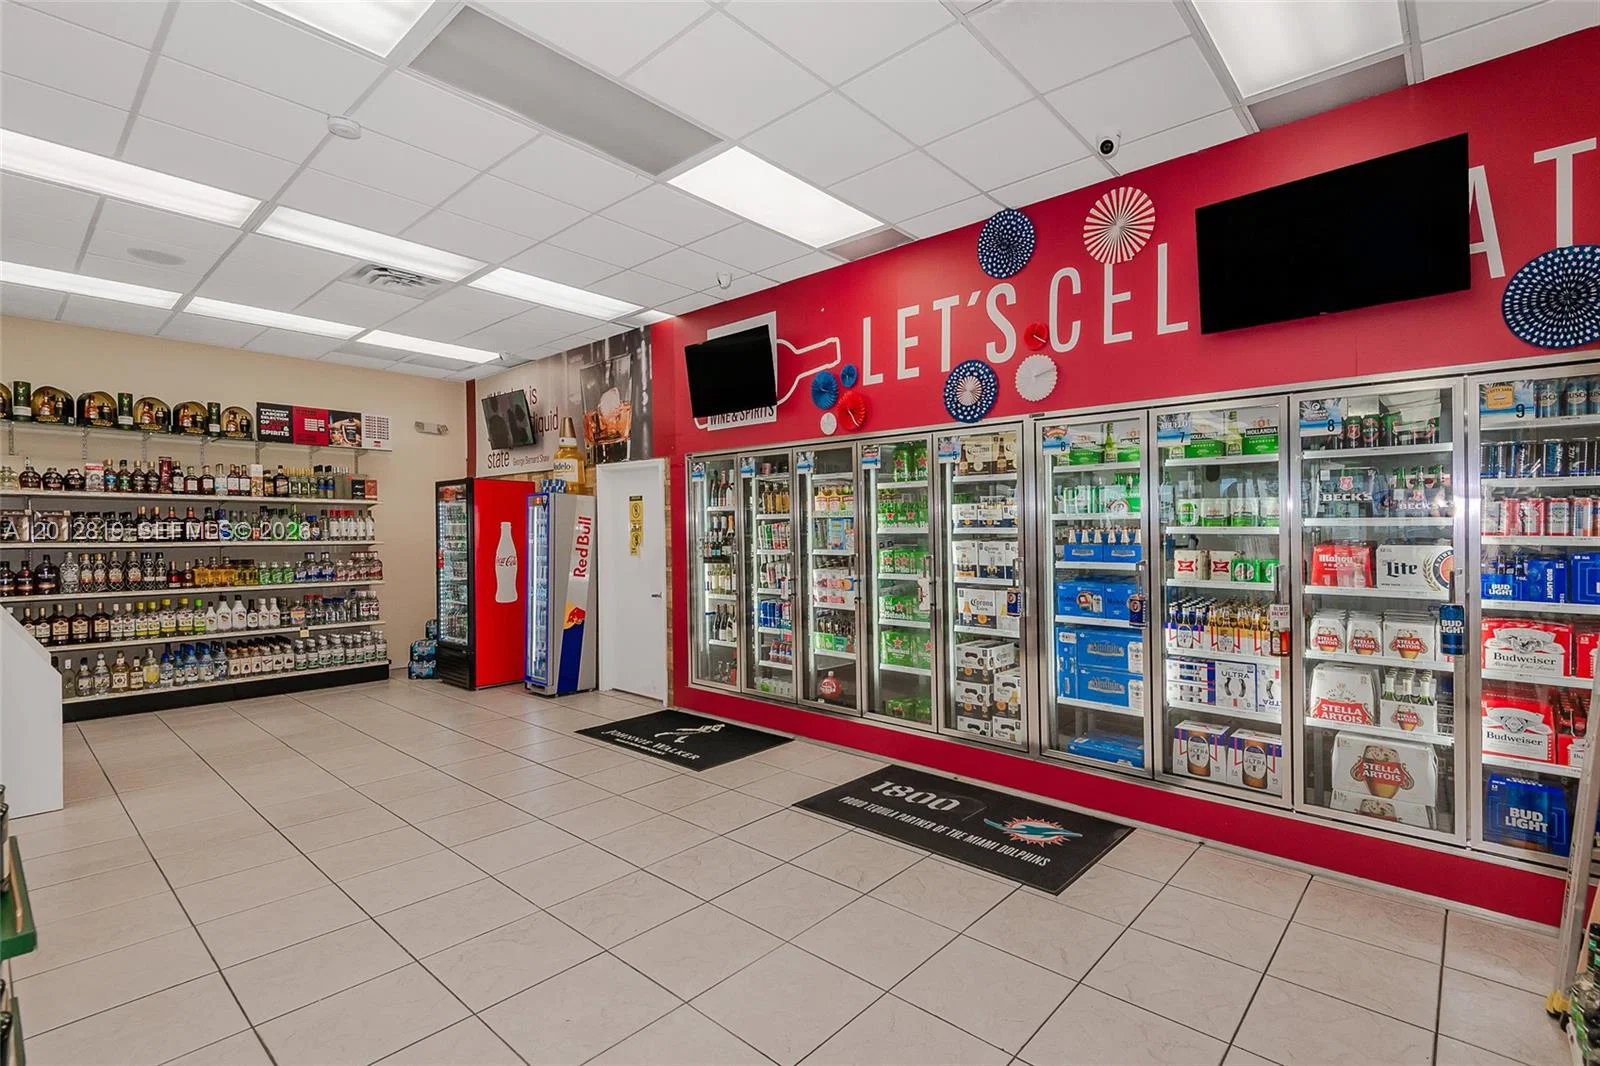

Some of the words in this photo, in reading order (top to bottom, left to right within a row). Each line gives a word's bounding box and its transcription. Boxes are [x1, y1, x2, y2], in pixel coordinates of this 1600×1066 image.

[862, 283, 1018, 387] LET'S
[710, 412, 730, 426] WINE
[740, 405, 774, 422] SPIRITS
[1515, 404, 1525, 418] 9
[1327, 419, 1335, 432] 8
[261, 429, 290, 437] SPIRITS
[1179, 431, 1185, 443] 7
[1060, 441, 1066, 452] 6
[488, 451, 510, 469] state
[952, 451, 958, 461] 5
[576, 516, 592, 546] Bull
[573, 547, 589, 578] Red
[1386, 561, 1418, 578] Lite
[1488, 588, 1513, 596] LIGHT
[1441, 619, 1463, 627] BUD
[1316, 635, 1338, 643] STELLA
[1353, 642, 1375, 650] ARTOIS
[1493, 652, 1557, 665] Budweiser
[1221, 670, 1250, 679] ULTRA
[1320, 702, 1362, 715] STELLA
[1320, 711, 1363, 724] ARTOIS
[600, 729, 653, 745] JOHNNIE
[652, 742, 701, 760] WALKER
[1486, 730, 1543, 746] Budweiser
[1362, 762, 1401, 775] STELLA
[1362, 770, 1402, 782] ARTOIS
[870, 780, 961, 811] 1800
[1509, 807, 1544, 823] BUD
[1505, 815, 1548, 833] LIGHT
[864, 803, 899, 818] TEQUILA
[895, 812, 937, 830] PARTNER
[932, 824, 951, 834] OF
[945, 828, 968, 840] THE
[963, 834, 1001, 850] MIAMI
[997, 844, 1051, 867] DOLPHINS
